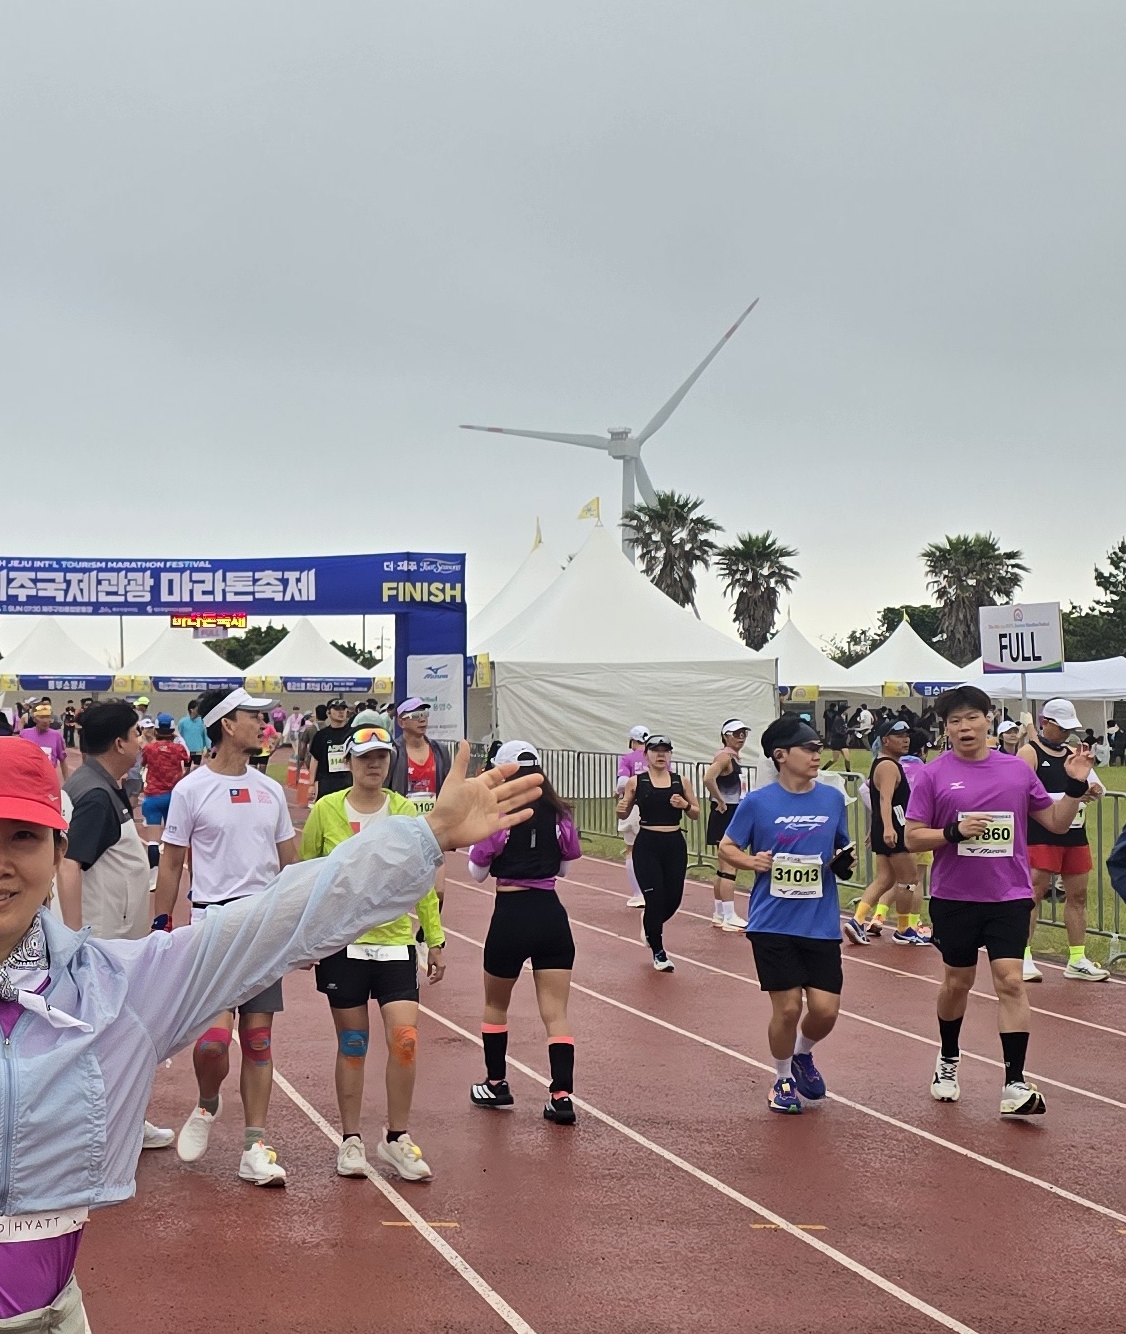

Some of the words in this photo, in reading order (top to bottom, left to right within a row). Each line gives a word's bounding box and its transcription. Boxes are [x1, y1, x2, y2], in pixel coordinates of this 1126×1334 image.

[8, 560, 32, 568] JEJU
[62, 561, 105, 569] TOURISM
[108, 561, 164, 569] MARATHON
[166, 560, 212, 568] FESTIVAL
[160, 568, 316, 603] 마라톤축제
[382, 582, 461, 603] FINISH
[998, 631, 1042, 662] FULL
[774, 815, 830, 824] NIKE
[774, 868, 819, 883] 31013
